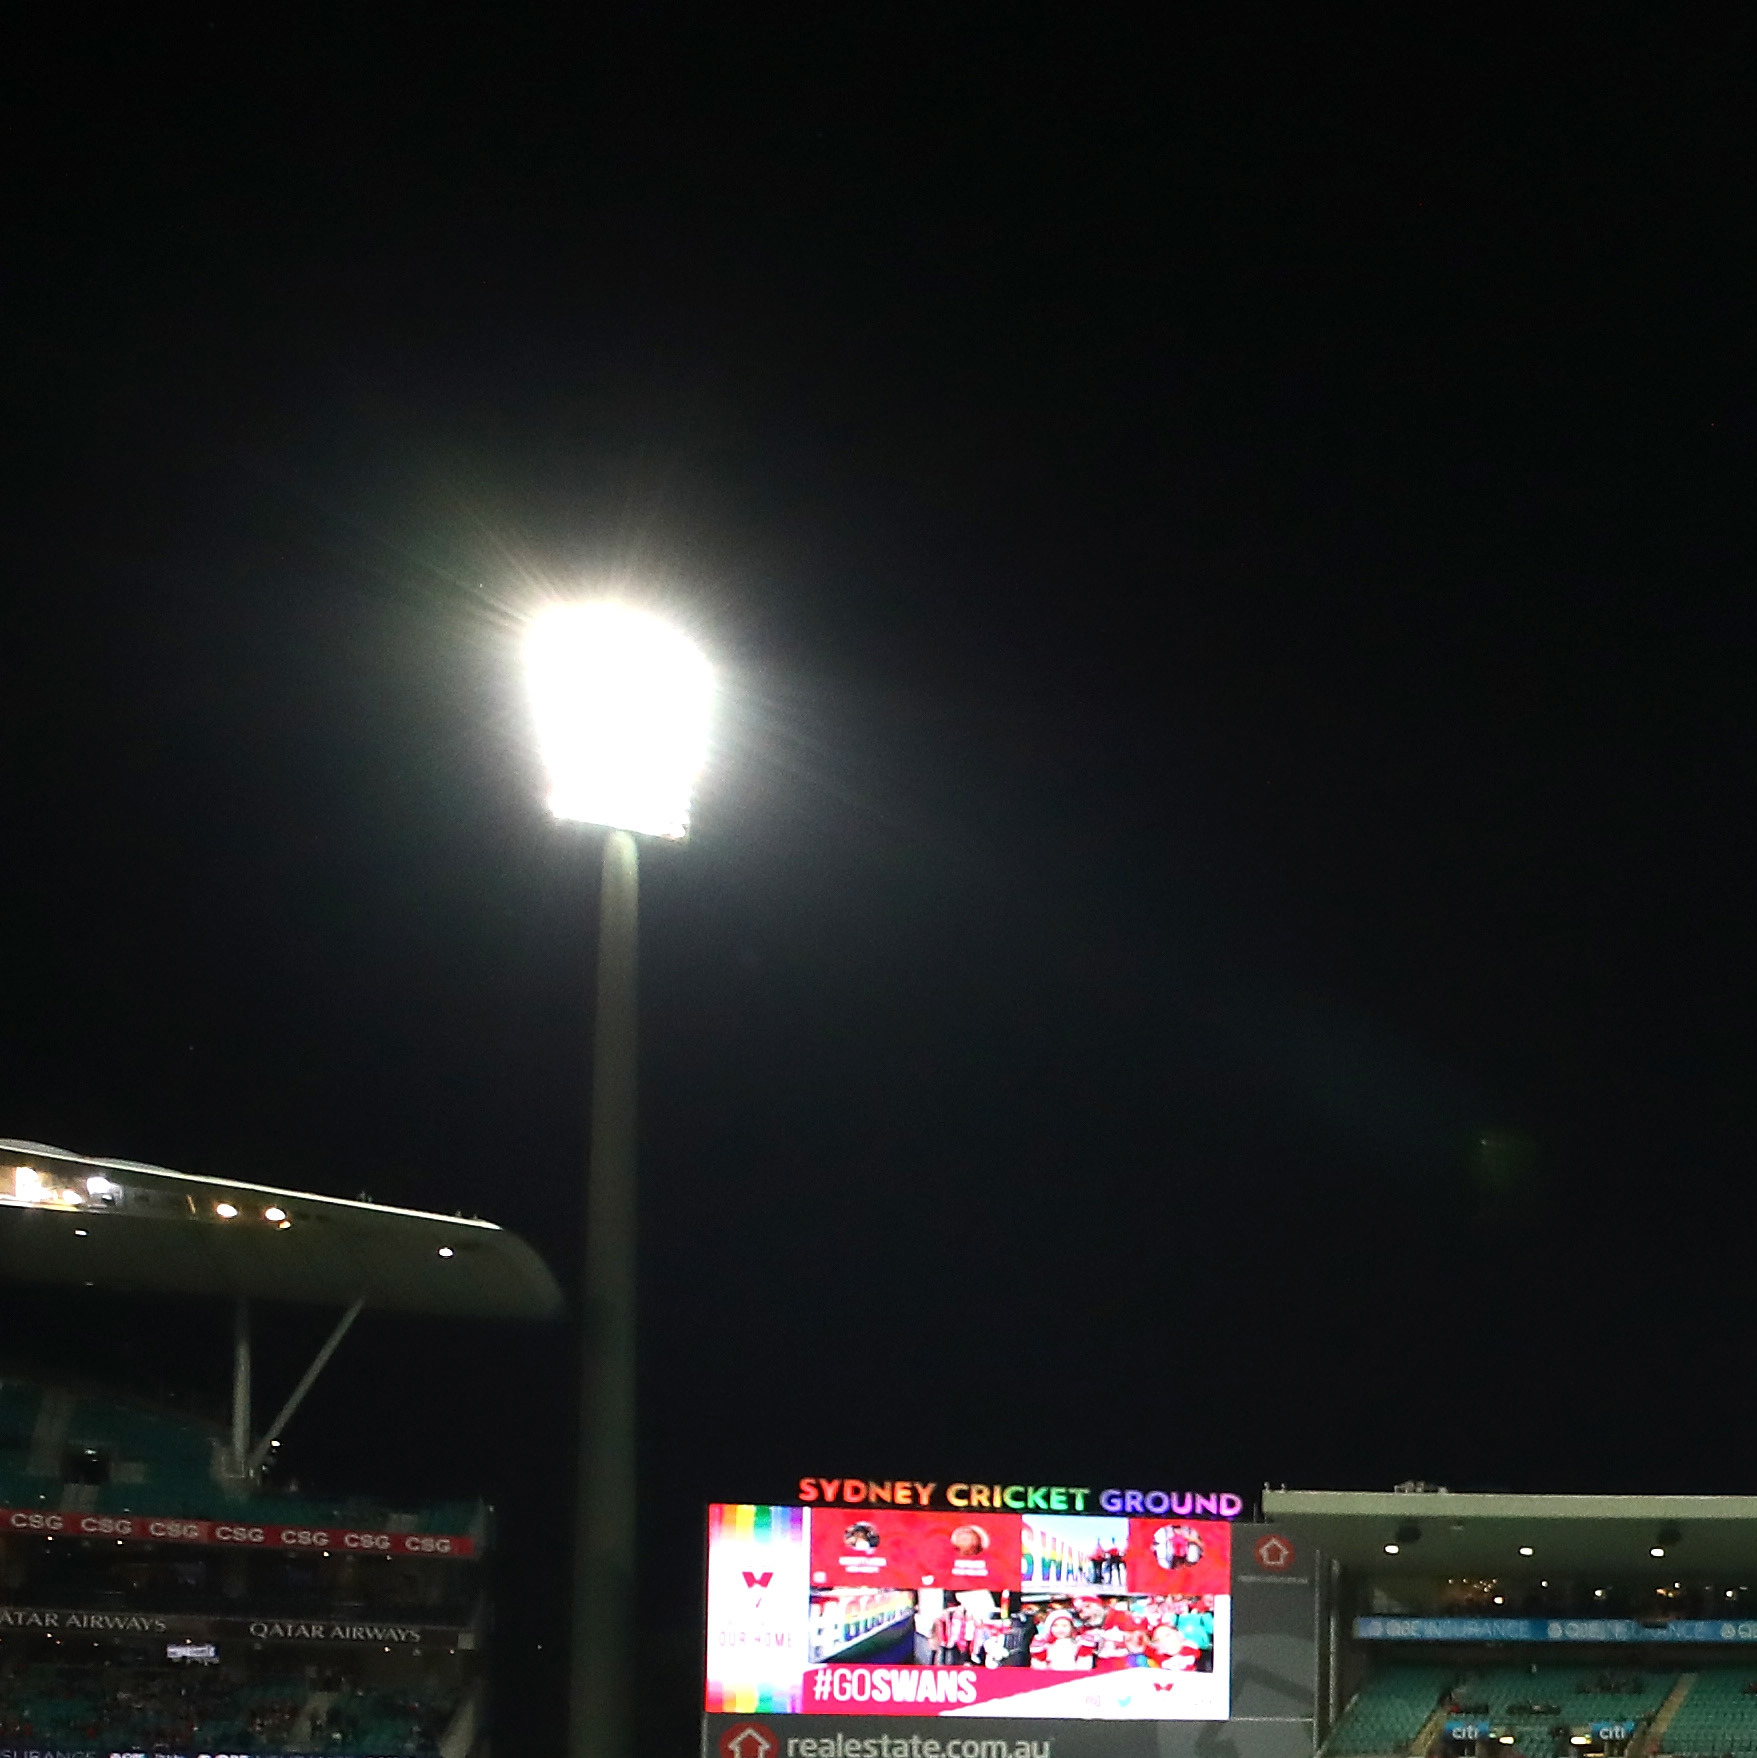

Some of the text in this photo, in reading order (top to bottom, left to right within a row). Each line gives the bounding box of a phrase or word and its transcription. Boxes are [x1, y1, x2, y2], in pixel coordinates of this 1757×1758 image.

[798, 1477, 1243, 1517] SYDNEY CRICKET GROUND
[11, 1512, 64, 1531] CSG
[81, 1517, 132, 1535] CSG
[149, 1521, 200, 1539] CSG
[215, 1525, 265, 1543] CSG
[281, 1529, 329, 1547] CSG
[344, 1533, 390, 1550] CSG
[405, 1536, 451, 1553] CSG
[0, 1611, 166, 1632] ATAR AIRWAYS
[250, 1623, 421, 1642] QATAR AIRWAYS
[814, 1668, 978, 1703] #GOSWANS
[1599, 1724, 1624, 1739] citi
